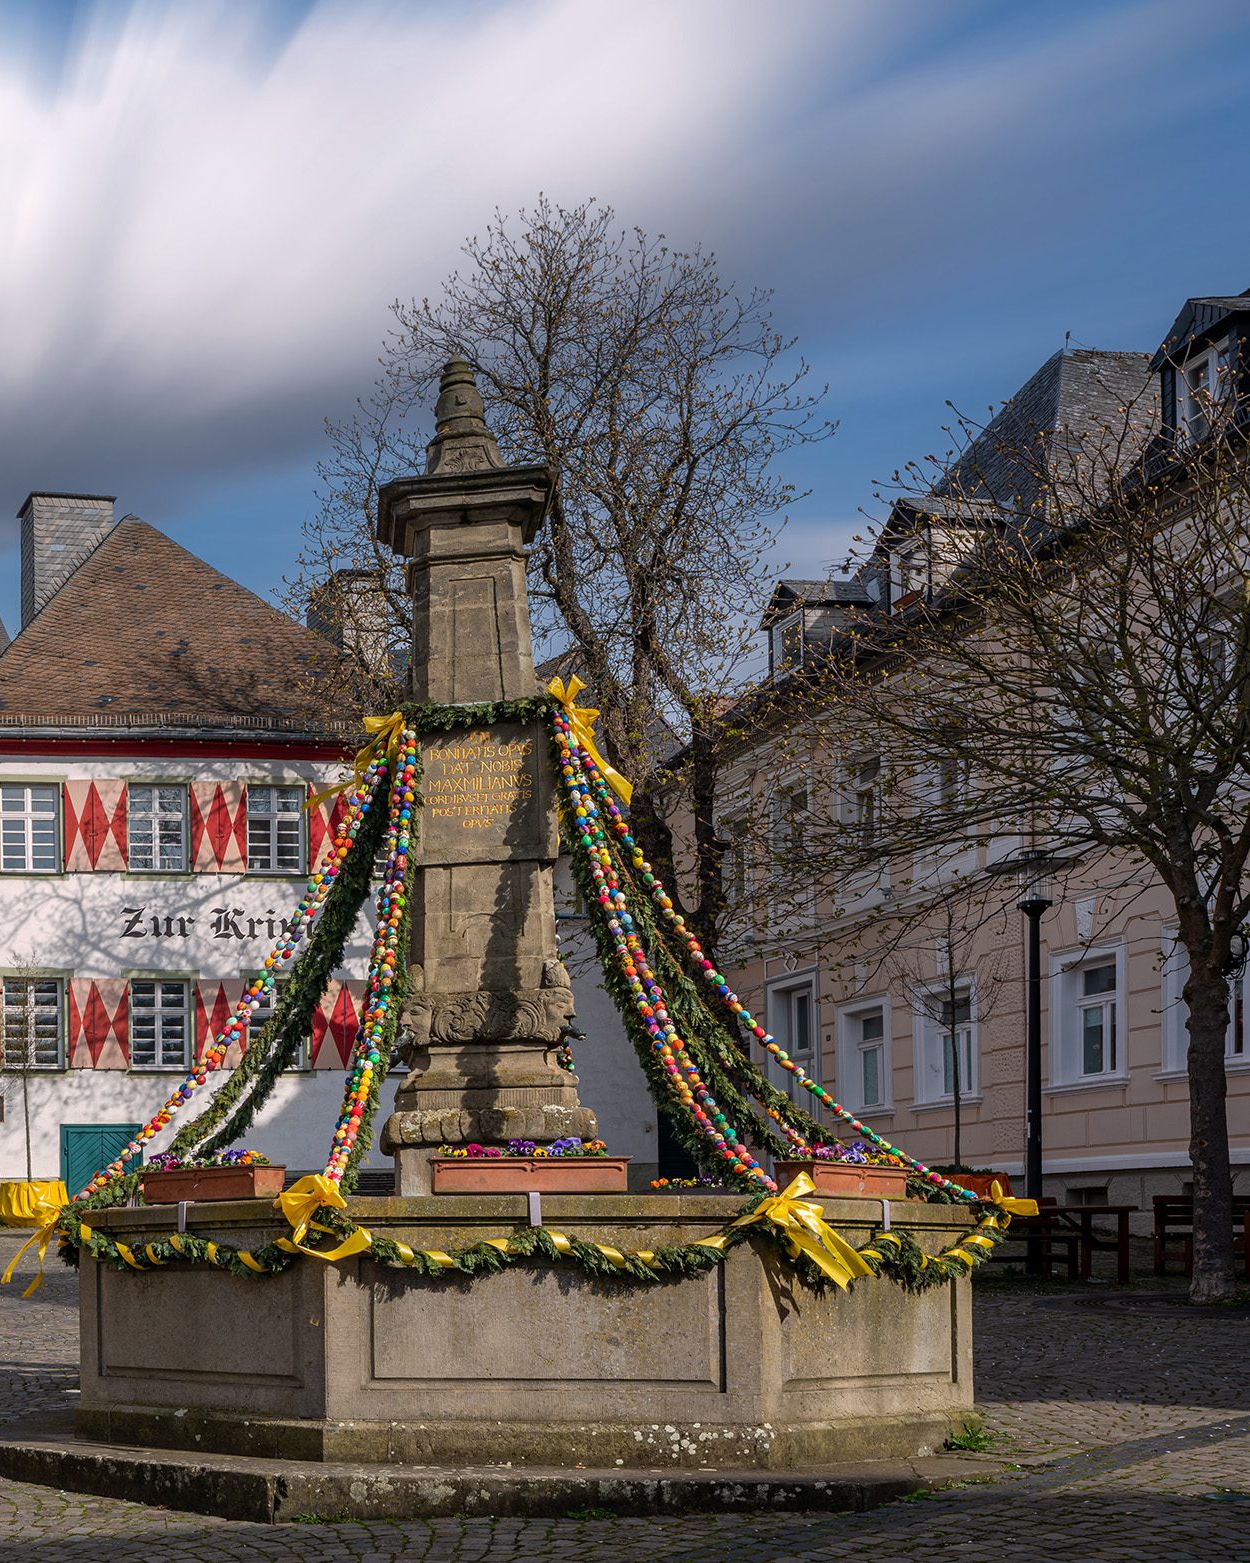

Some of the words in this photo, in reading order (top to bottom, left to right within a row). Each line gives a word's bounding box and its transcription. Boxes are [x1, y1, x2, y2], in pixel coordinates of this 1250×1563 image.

[442, 761, 473, 775] DAT
[481, 759, 523, 773] NOBIS
[463, 818, 494, 828] OPVS
[119, 906, 196, 938] Zur
